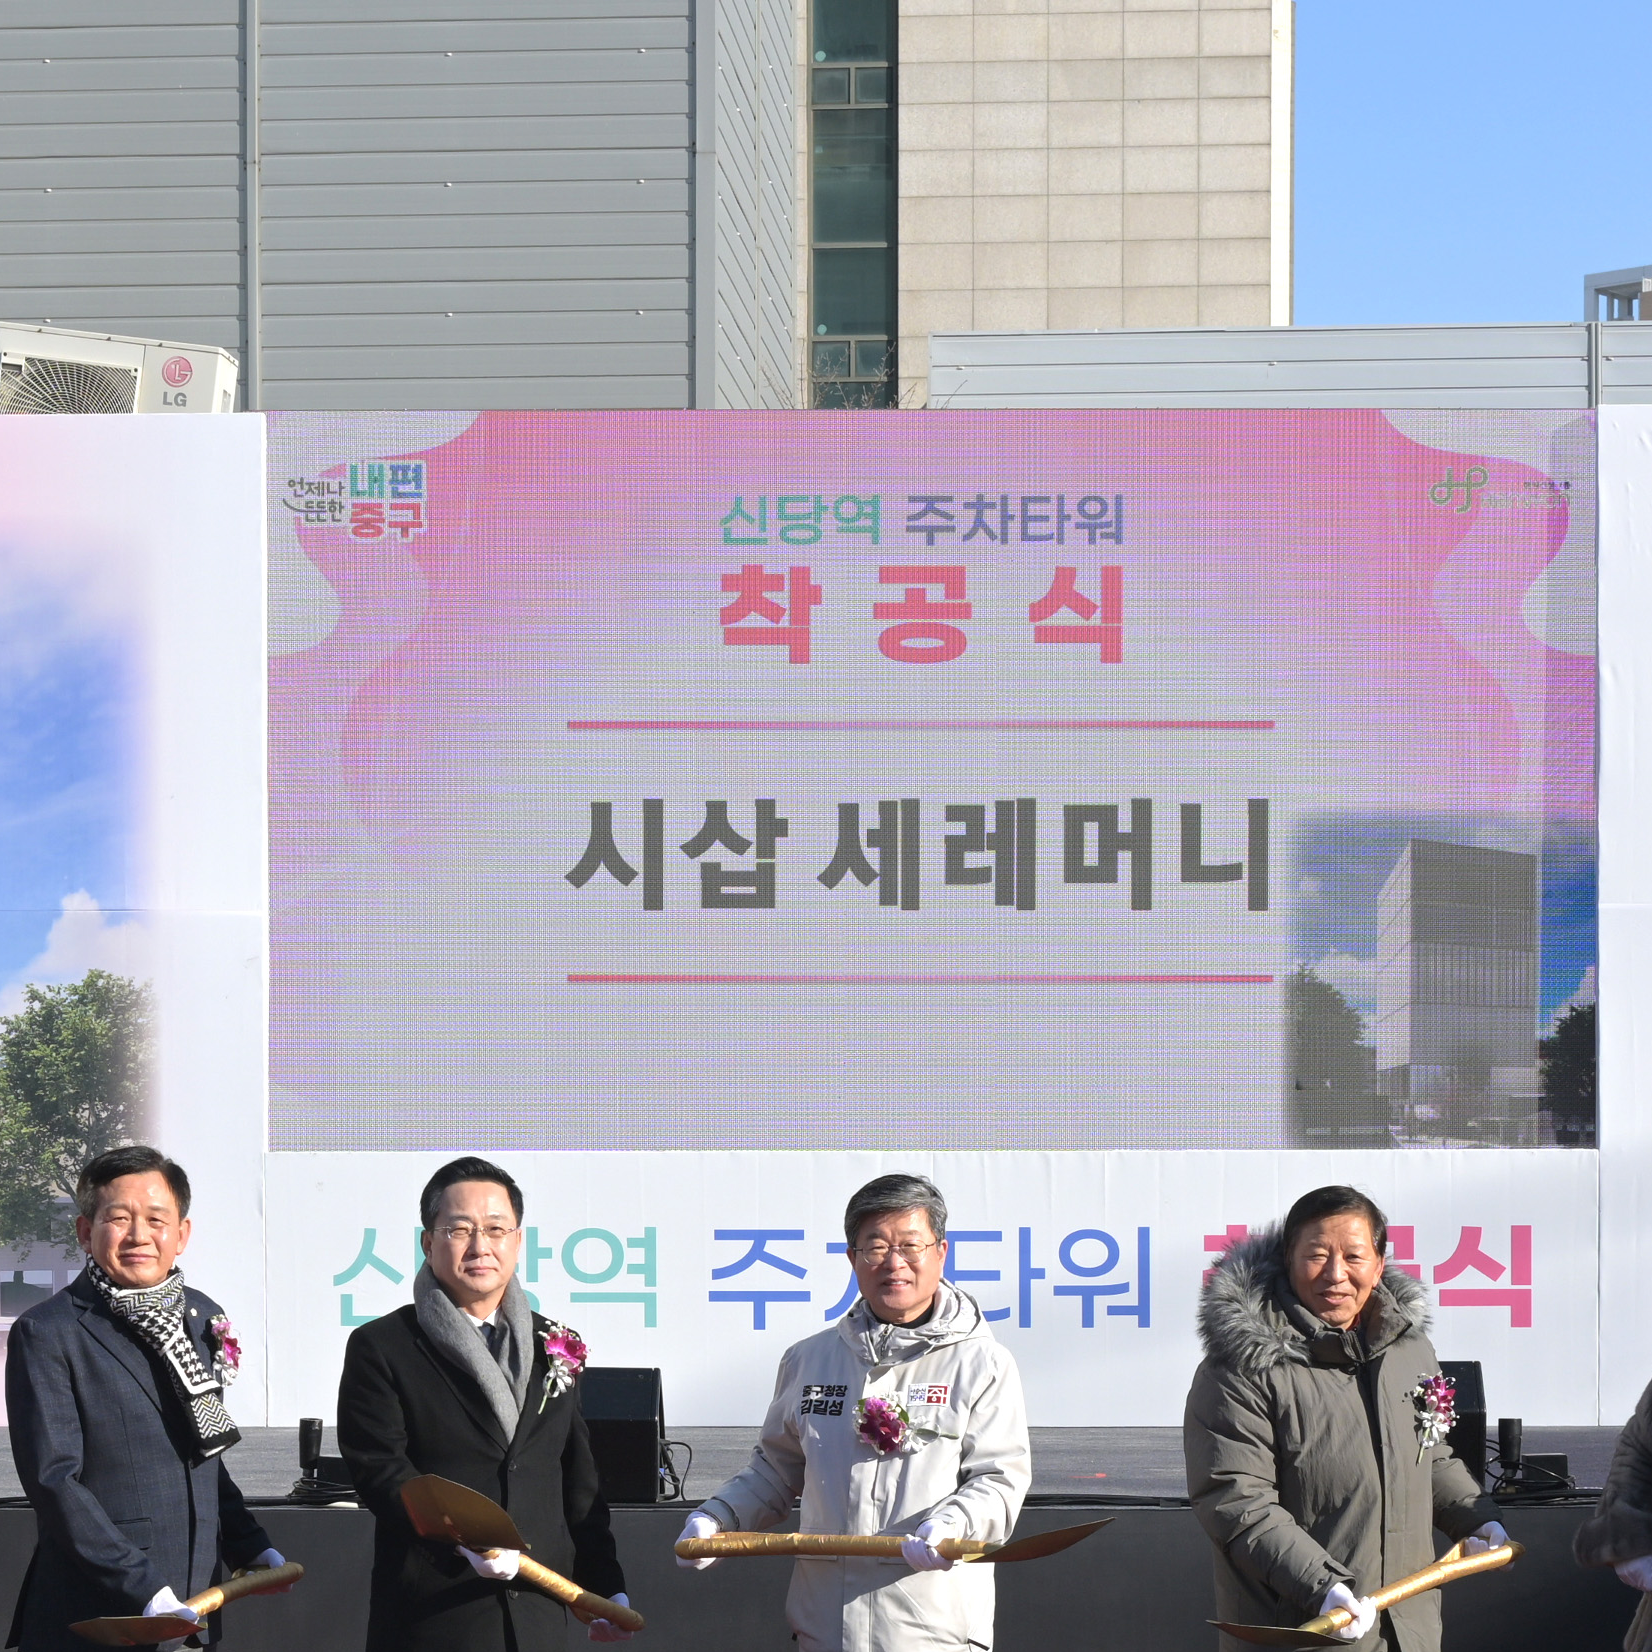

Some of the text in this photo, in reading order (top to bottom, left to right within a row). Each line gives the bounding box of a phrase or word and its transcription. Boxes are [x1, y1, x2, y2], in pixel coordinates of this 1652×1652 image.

[162, 391, 187, 407] LG
[288, 477, 345, 497] 언제나
[350, 464, 423, 498] 내편
[350, 503, 423, 538] 중구
[718, 492, 1126, 547] 신당역 주차타워
[565, 797, 1270, 911] 시삽 세레머니
[800, 1399, 844, 1416] 김길성
